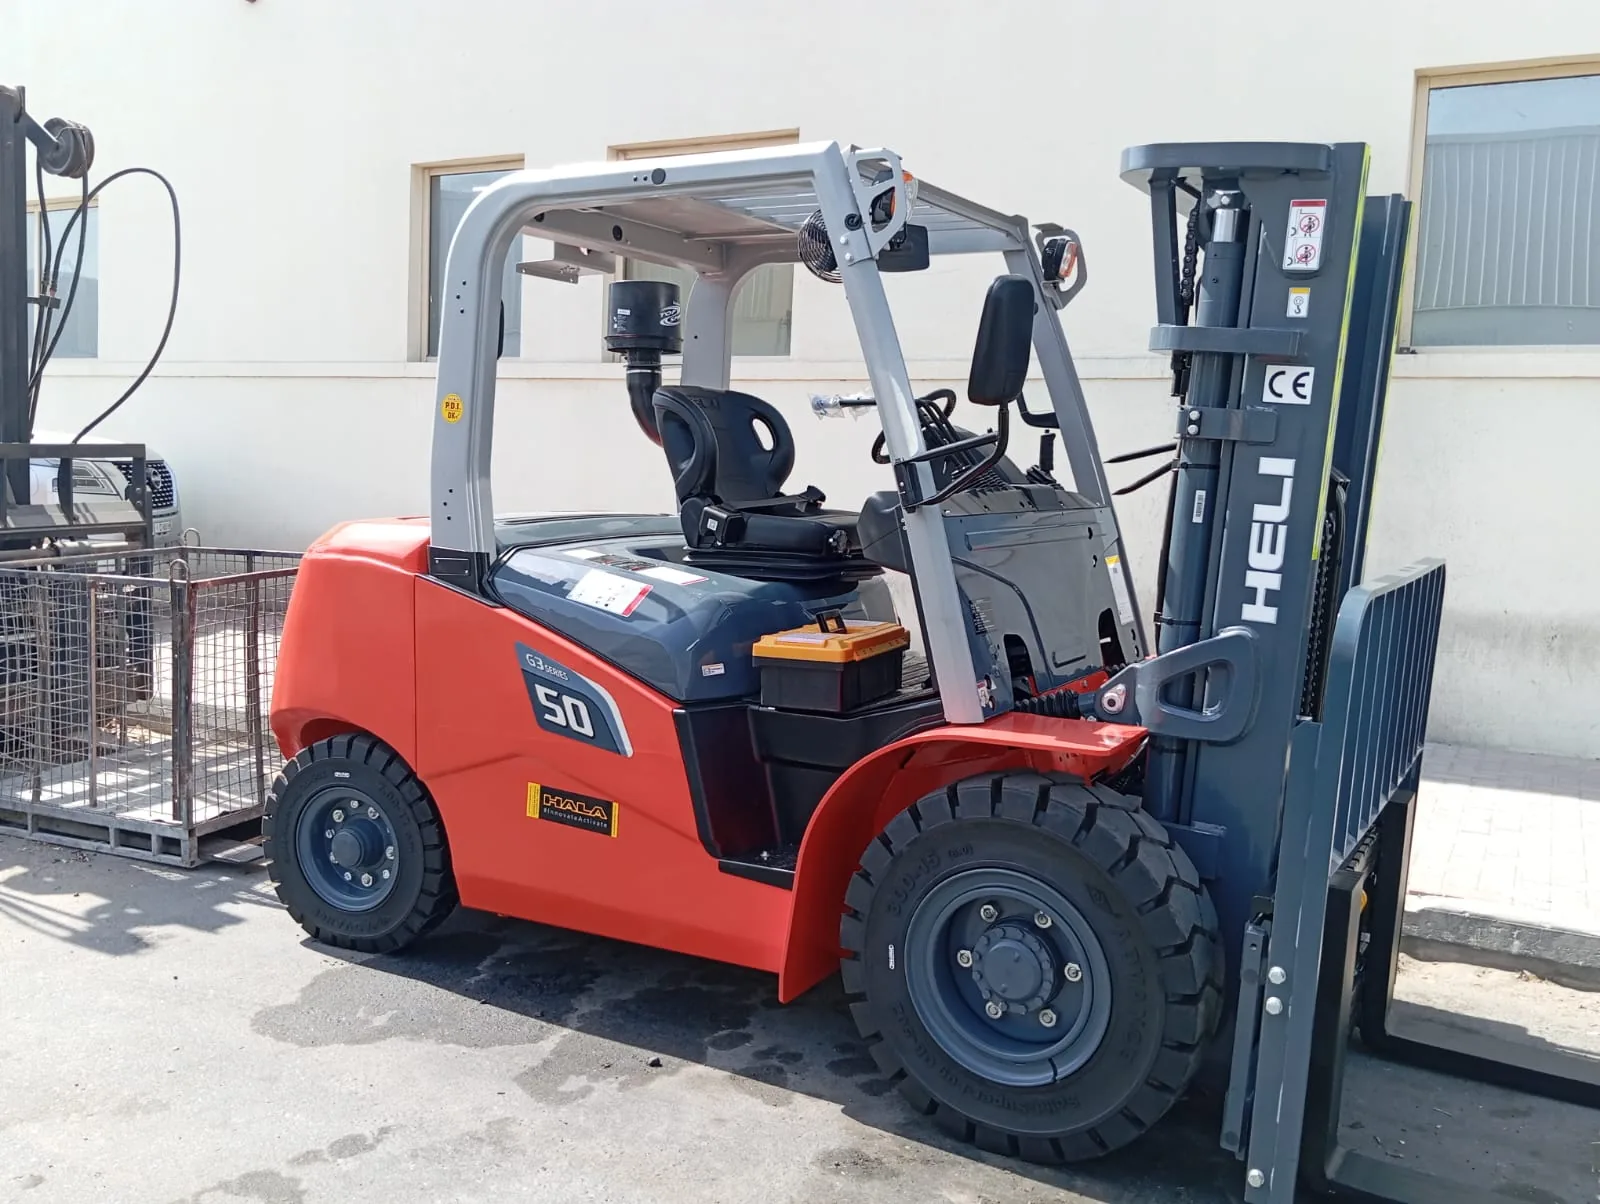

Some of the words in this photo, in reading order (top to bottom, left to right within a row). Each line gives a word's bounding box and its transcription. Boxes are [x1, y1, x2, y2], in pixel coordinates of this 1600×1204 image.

[1269, 370, 1310, 399] CE
[1241, 457, 1296, 624] HELI
[526, 653, 545, 671] G3
[544, 664, 569, 681] SERIES
[534, 683, 594, 737] 50
[543, 794, 608, 820] HALA
[543, 807, 608, 828] #InnovateActivate
